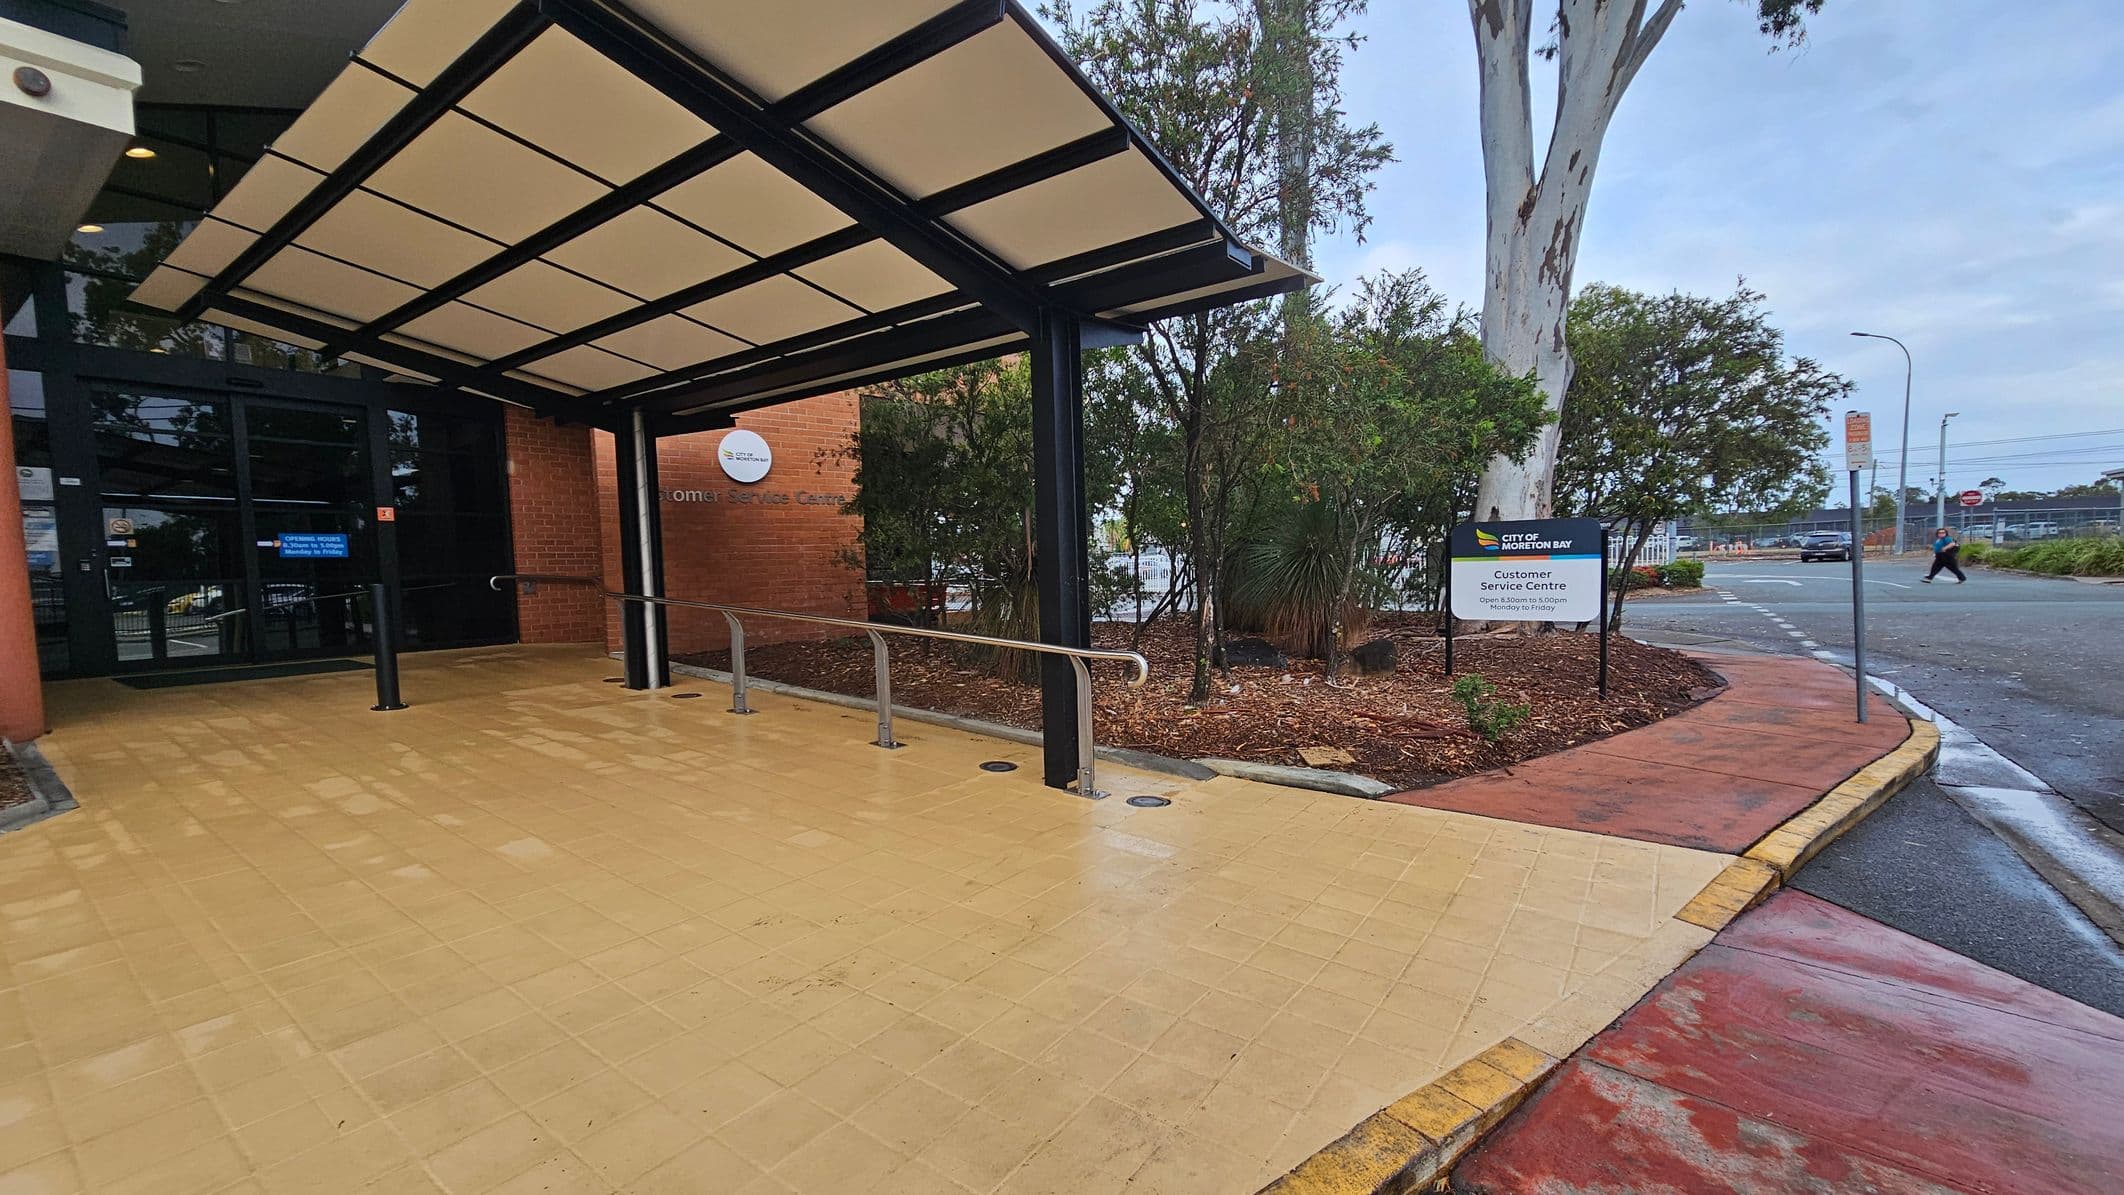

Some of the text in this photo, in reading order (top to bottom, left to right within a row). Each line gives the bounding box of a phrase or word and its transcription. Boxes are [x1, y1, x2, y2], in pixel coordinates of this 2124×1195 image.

[728, 489, 789, 504] Service
[795, 490, 846, 505] Centre
[1501, 533, 1539, 542] CITY OF
[1501, 540, 1572, 550] MORETON BAY
[1494, 570, 1552, 579] Customer
[1480, 582, 1567, 591] Service Centre
[1531, 604, 1555, 612] Friday
